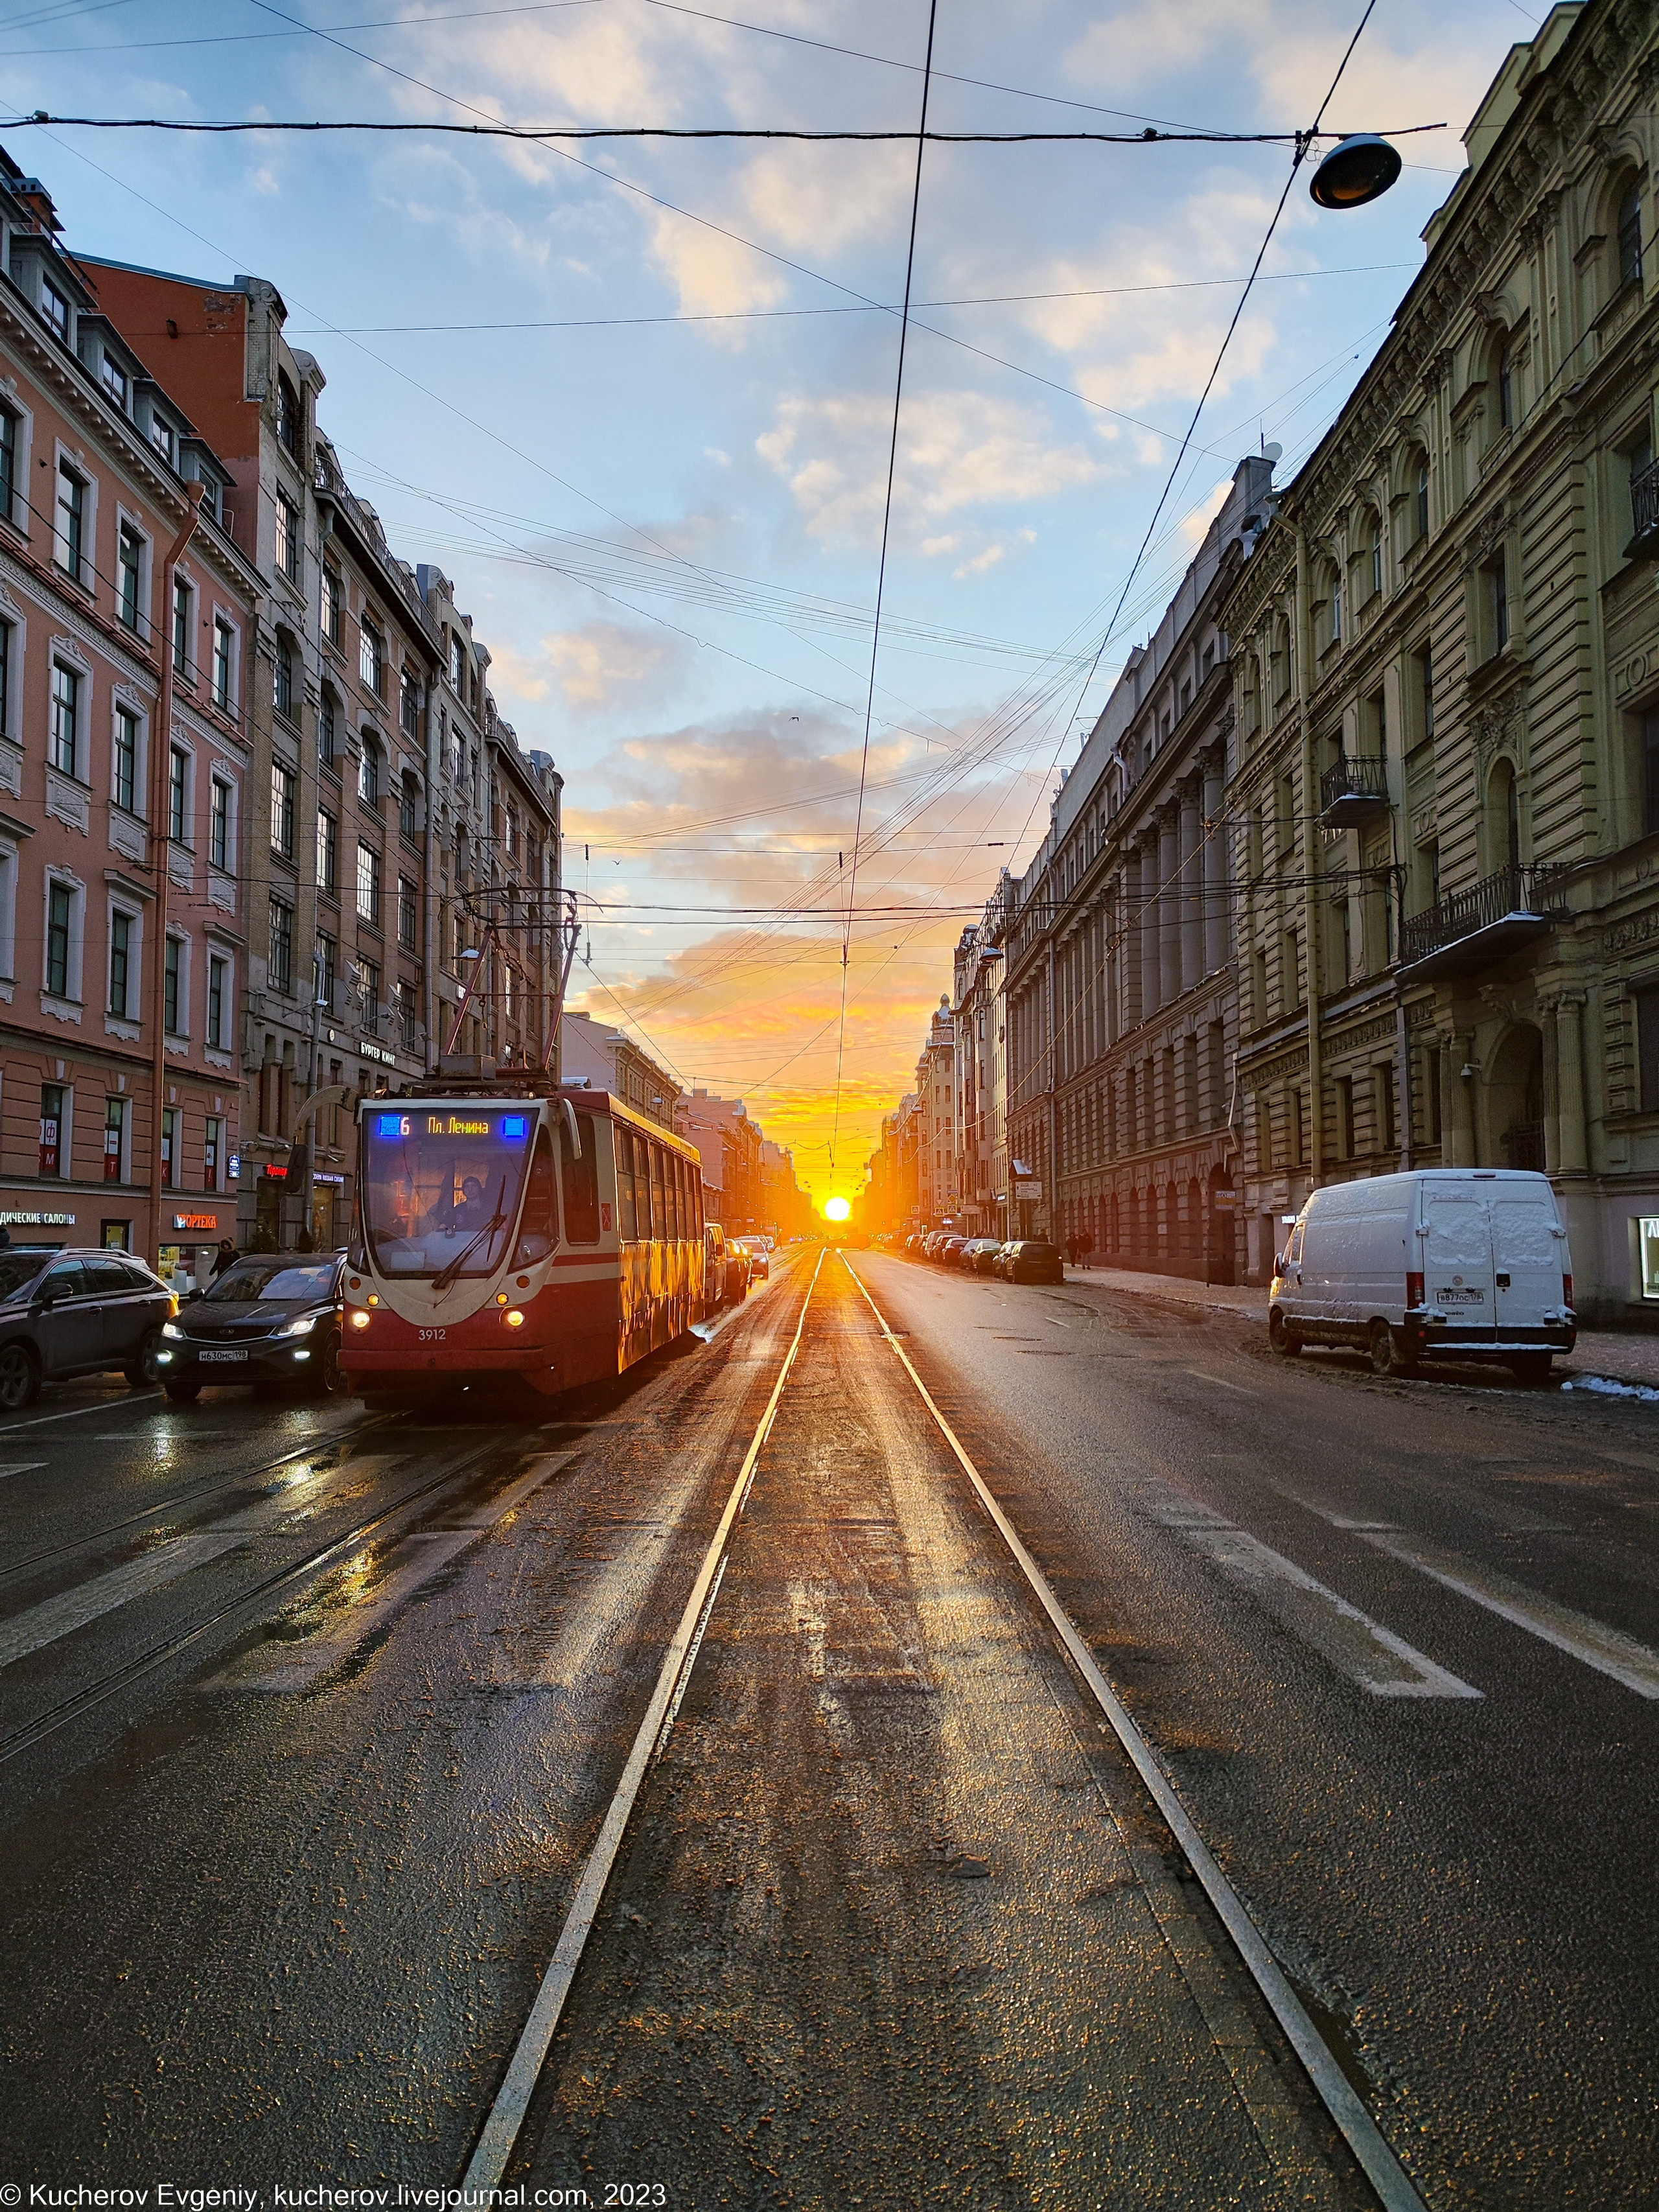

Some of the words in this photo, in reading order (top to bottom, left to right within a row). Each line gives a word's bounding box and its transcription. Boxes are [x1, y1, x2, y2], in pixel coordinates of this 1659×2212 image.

[361, 1042, 380, 1059] БУРГЕР
[382, 1051, 395, 1065] КИНГ
[401, 1117, 410, 1135] 6
[428, 1117, 445, 1134] Пл.
[448, 1117, 489, 1134] Ленина
[43, 1213, 75, 1225] САЛОНЫ
[186, 1215, 217, 1228] ОРТЕКА
[418, 1329, 447, 1341] 3912
